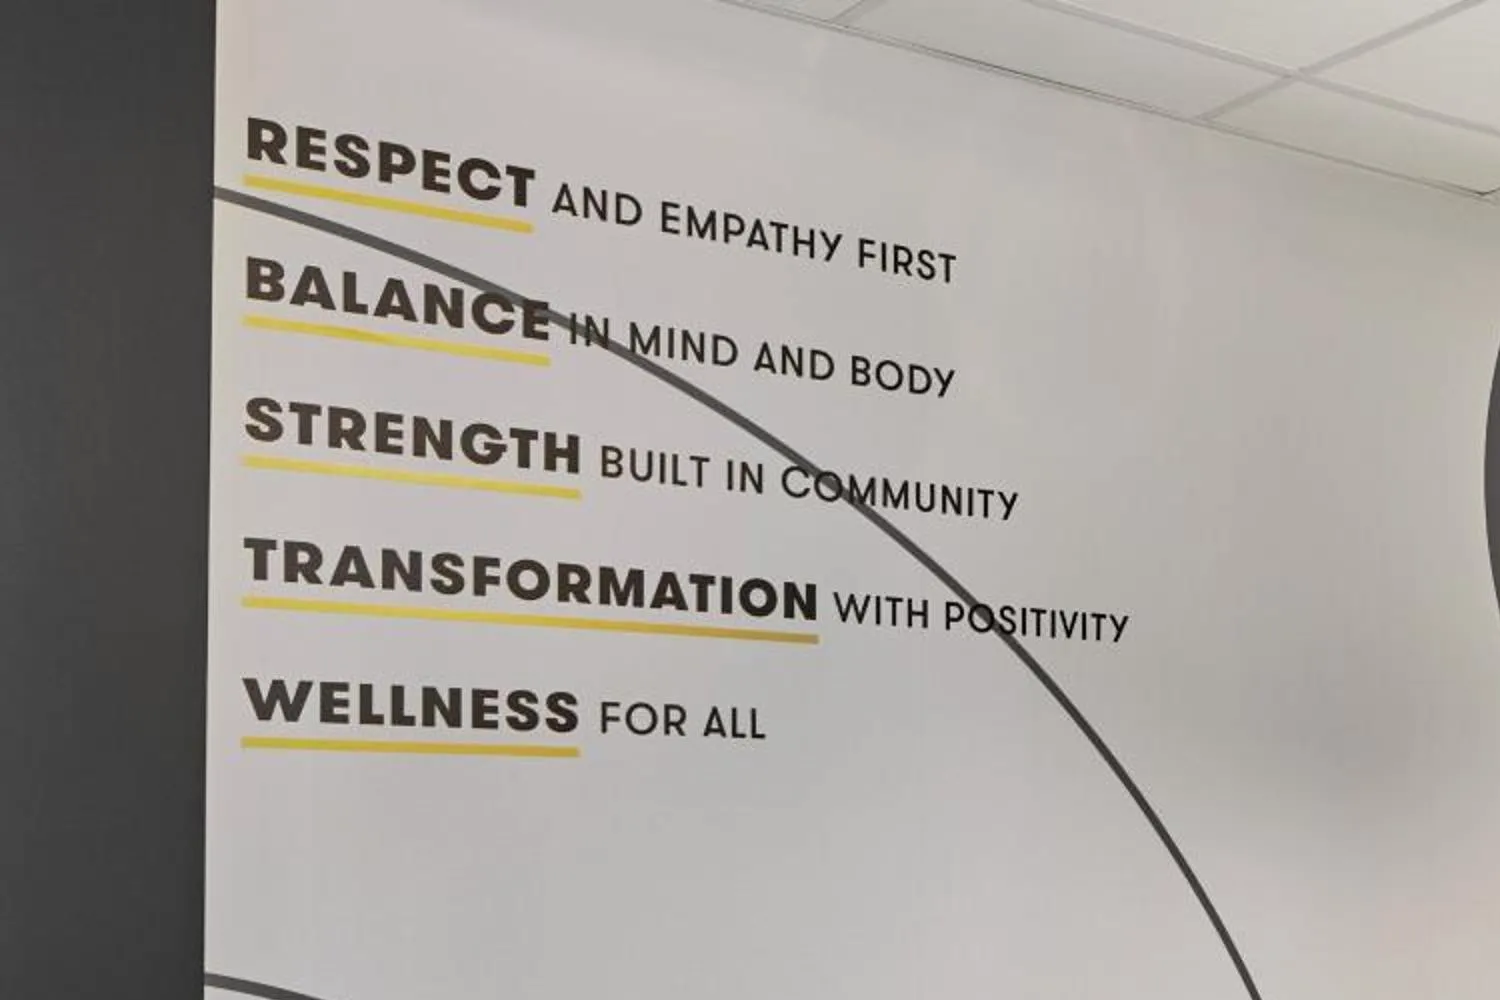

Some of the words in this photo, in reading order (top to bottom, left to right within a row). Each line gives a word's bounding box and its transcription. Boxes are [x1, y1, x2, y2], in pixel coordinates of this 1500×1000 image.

[247, 117, 535, 207] RESPECT
[551, 183, 642, 226] AND
[661, 201, 843, 262] EMPATHY
[858, 238, 956, 283] FIRST
[246, 256, 549, 341] BALANCE
[570, 312, 608, 349] IN
[629, 321, 738, 366] MIND
[753, 342, 834, 381] AND
[851, 355, 955, 398] BODY
[245, 397, 580, 474] STRENGTH
[600, 446, 709, 488] BUILT
[727, 460, 763, 494] IN
[781, 465, 1018, 520] COMMUNITY
[244, 537, 817, 621] TRANSFORMATION
[833, 591, 929, 629] WITH
[945, 602, 1129, 642] POSITIVITY
[242, 678, 580, 733] WELLNESS
[600, 702, 686, 736] FOR
[703, 706, 766, 739] ALL
